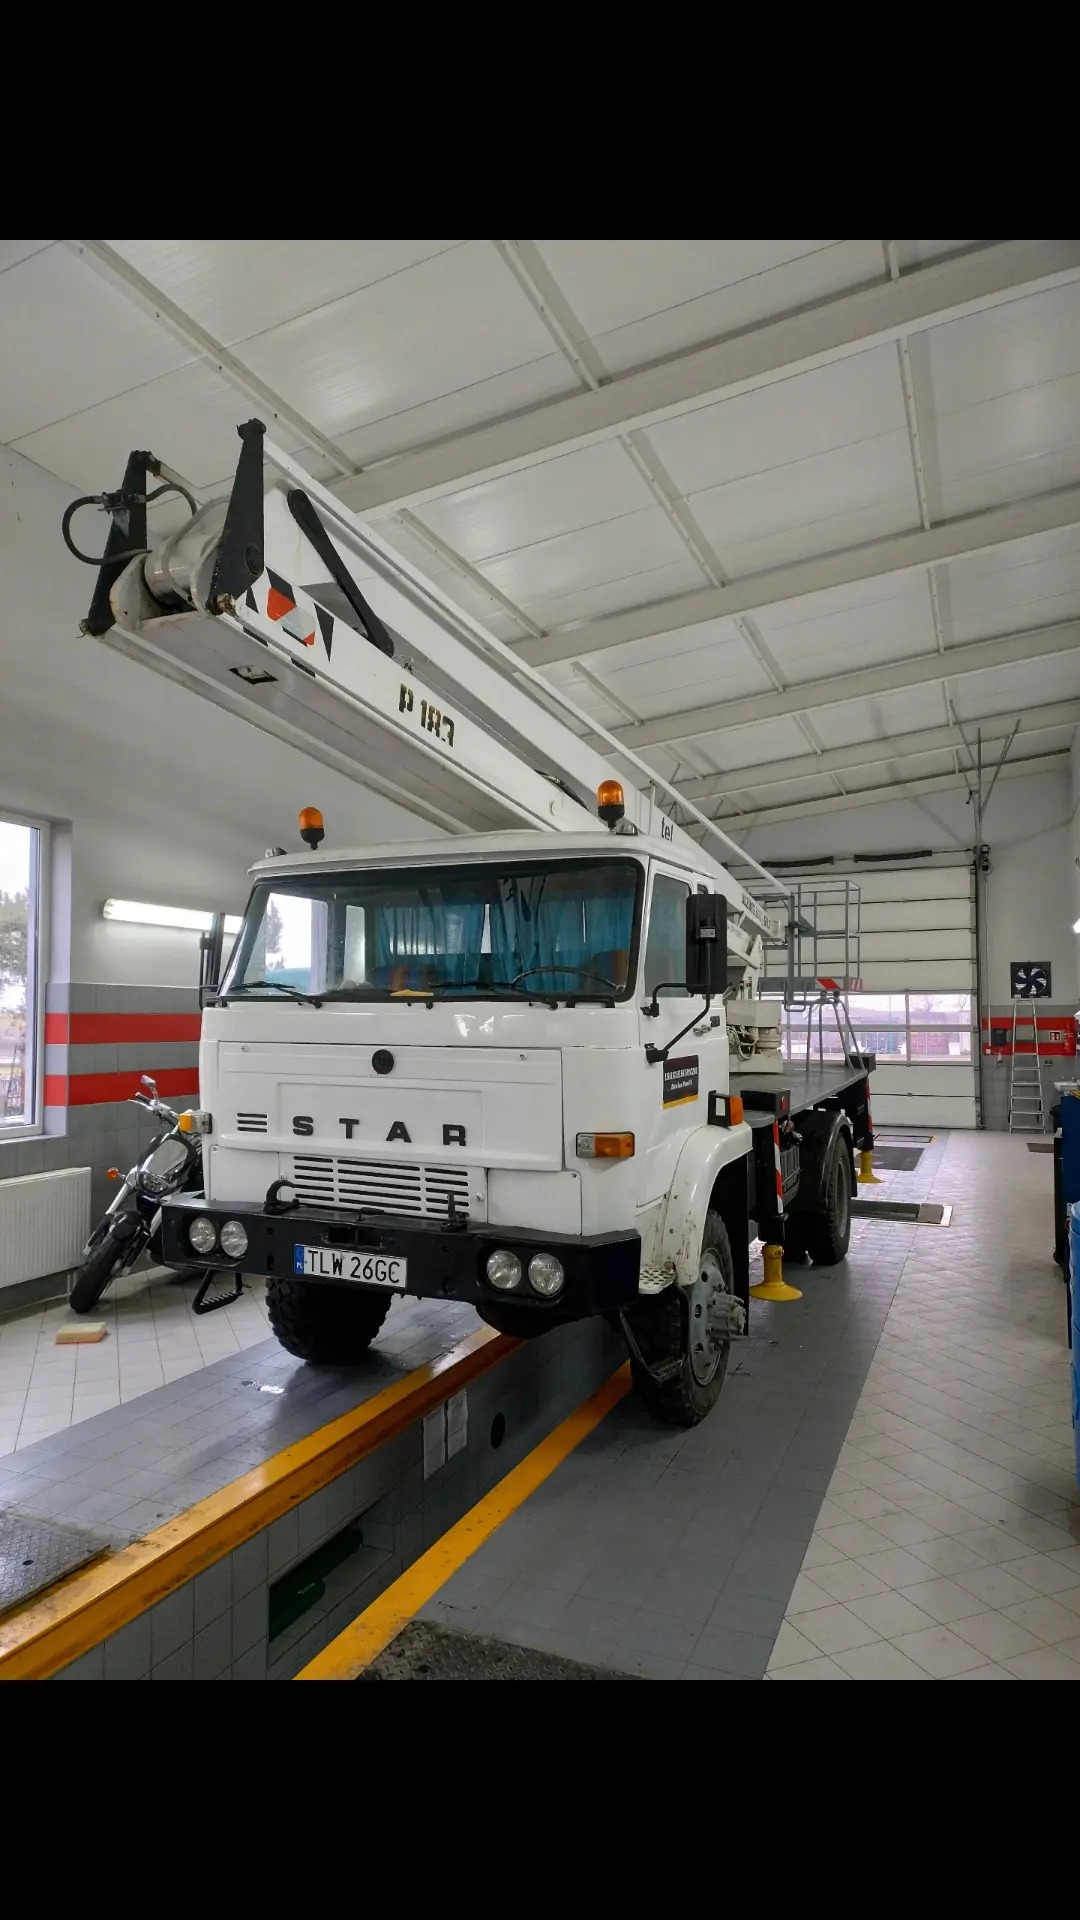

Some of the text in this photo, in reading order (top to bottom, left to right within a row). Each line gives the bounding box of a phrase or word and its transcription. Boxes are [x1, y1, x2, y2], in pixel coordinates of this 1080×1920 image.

[398, 682, 413, 713] P
[292, 1115, 467, 1147] STAR
[308, 1249, 400, 1283] TLW 26GC
